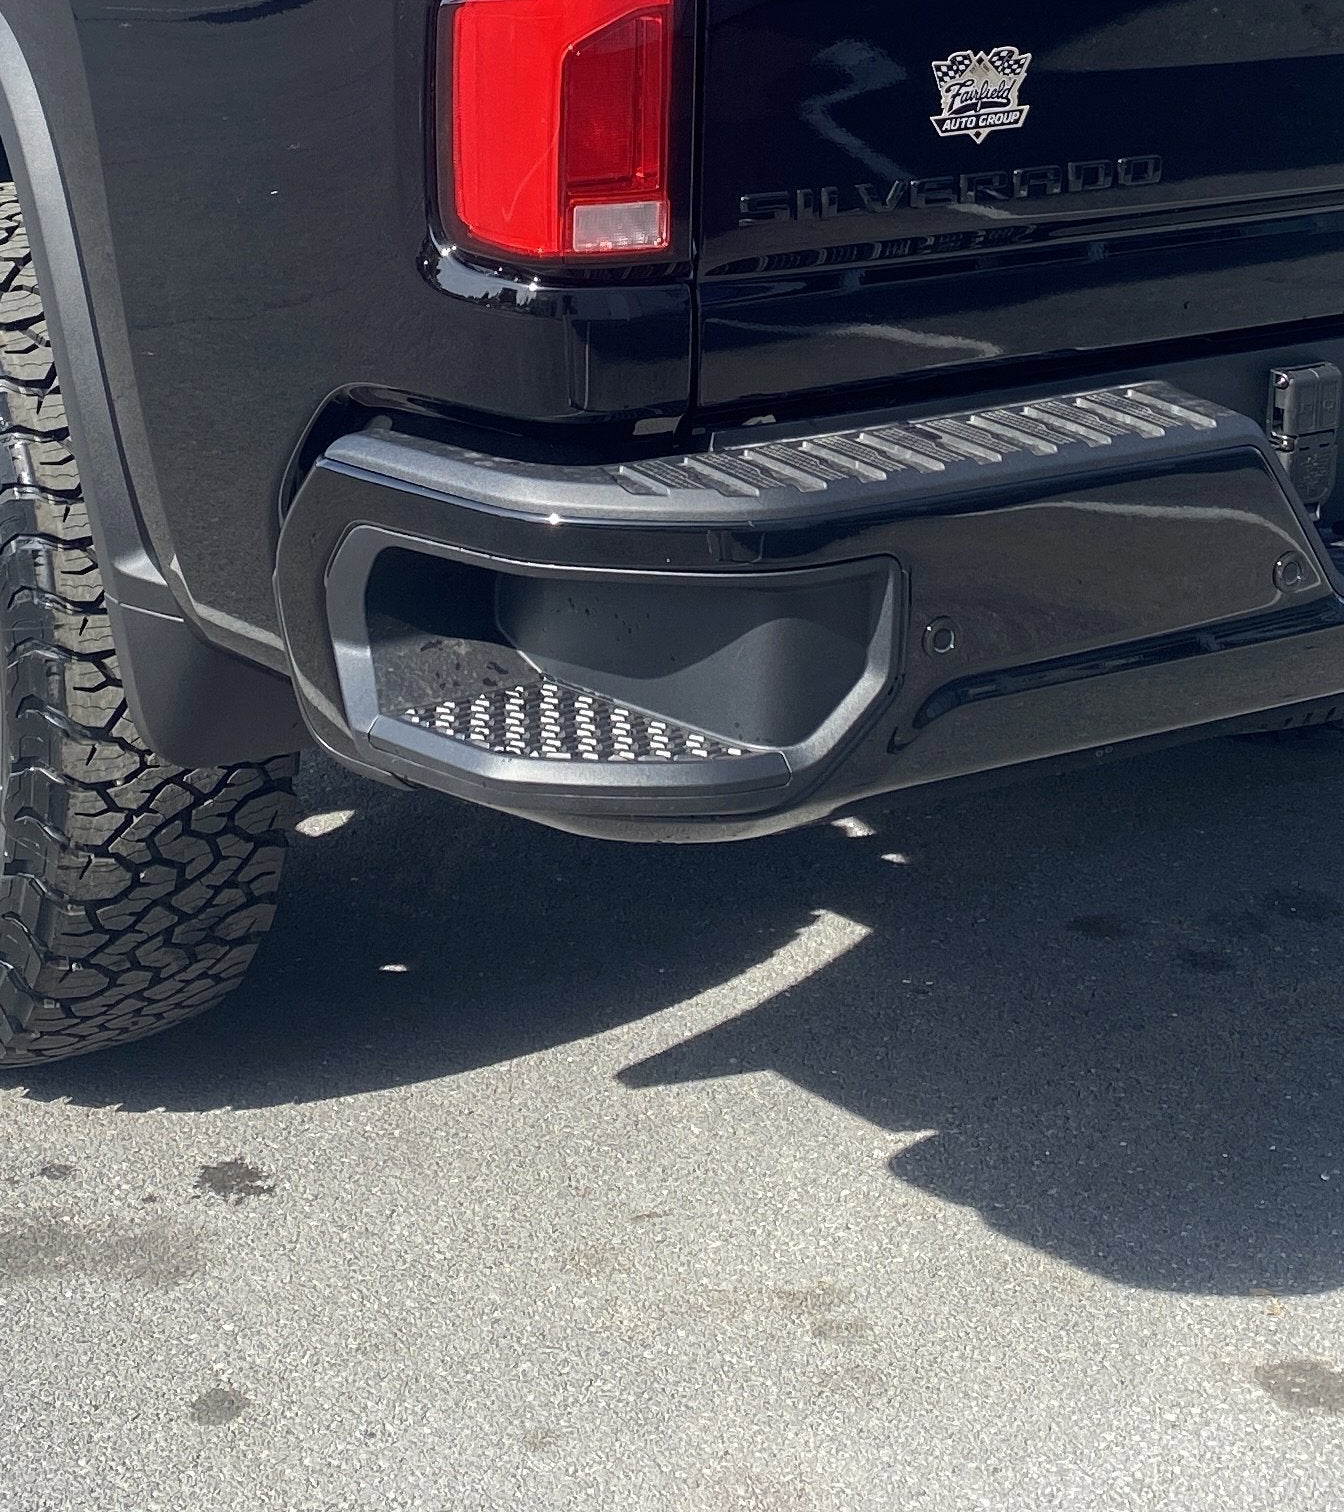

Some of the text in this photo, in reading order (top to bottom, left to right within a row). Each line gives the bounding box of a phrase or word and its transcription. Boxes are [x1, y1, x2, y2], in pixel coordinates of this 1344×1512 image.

[944, 78, 1017, 116] Fairfield
[941, 111, 1021, 132] AUTO GROUP
[739, 154, 1162, 227] SILVERADO
